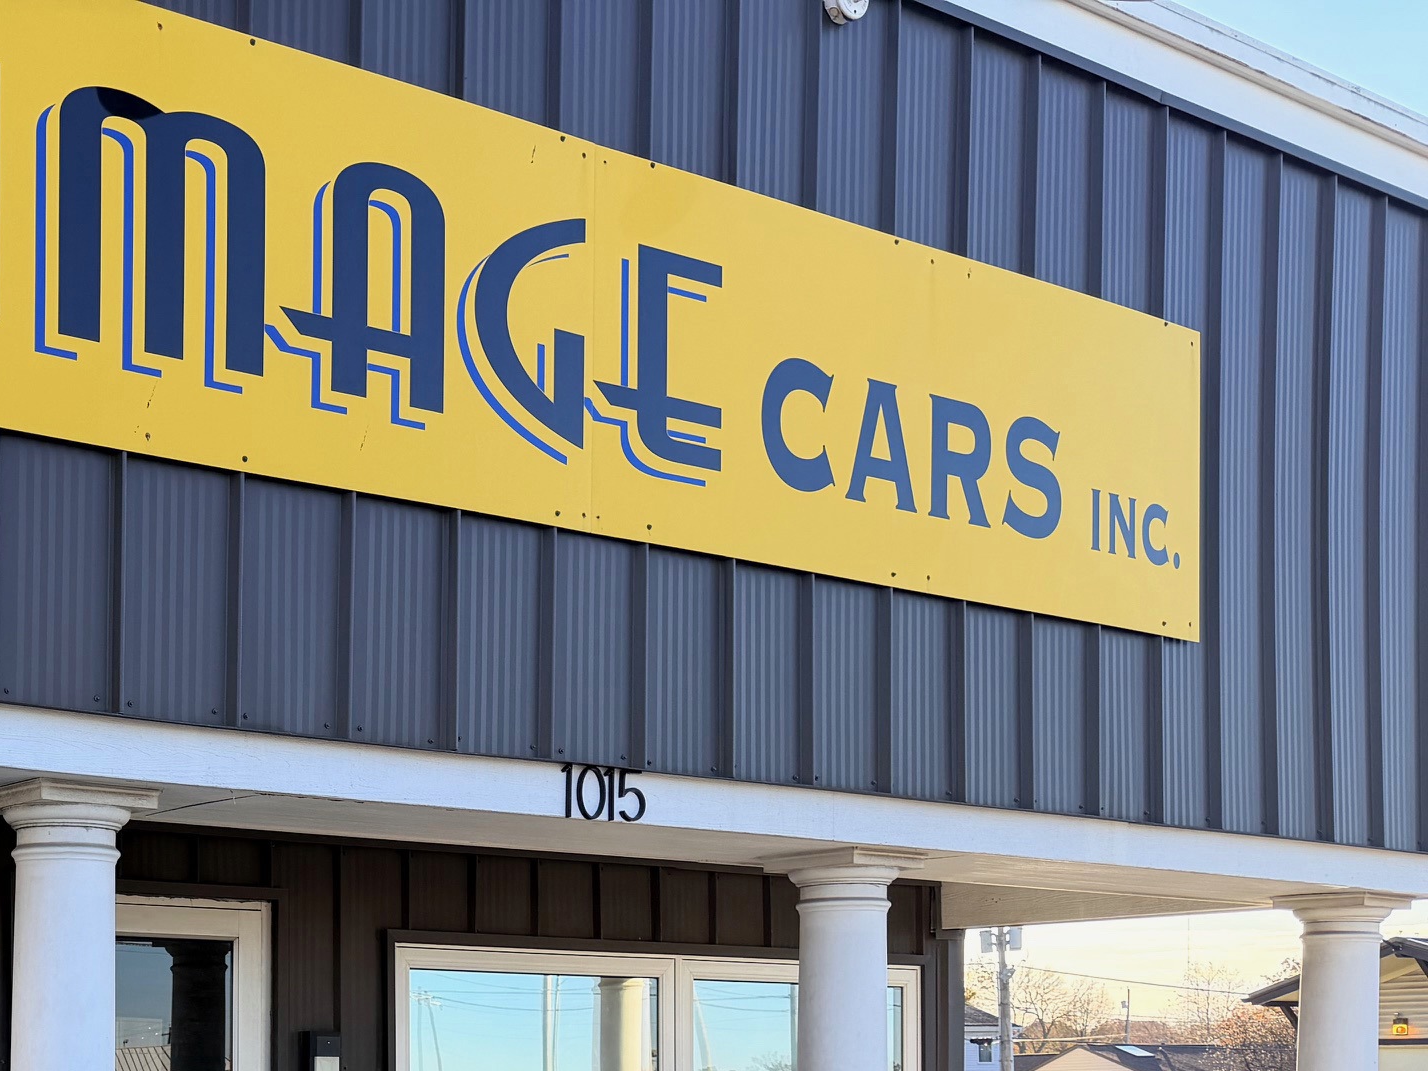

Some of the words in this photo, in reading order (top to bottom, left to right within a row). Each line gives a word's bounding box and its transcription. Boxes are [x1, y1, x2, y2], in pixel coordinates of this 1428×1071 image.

[762, 357, 1062, 539] CARS
[1090, 488, 1181, 570] INC.
[560, 762, 647, 822] 1015
